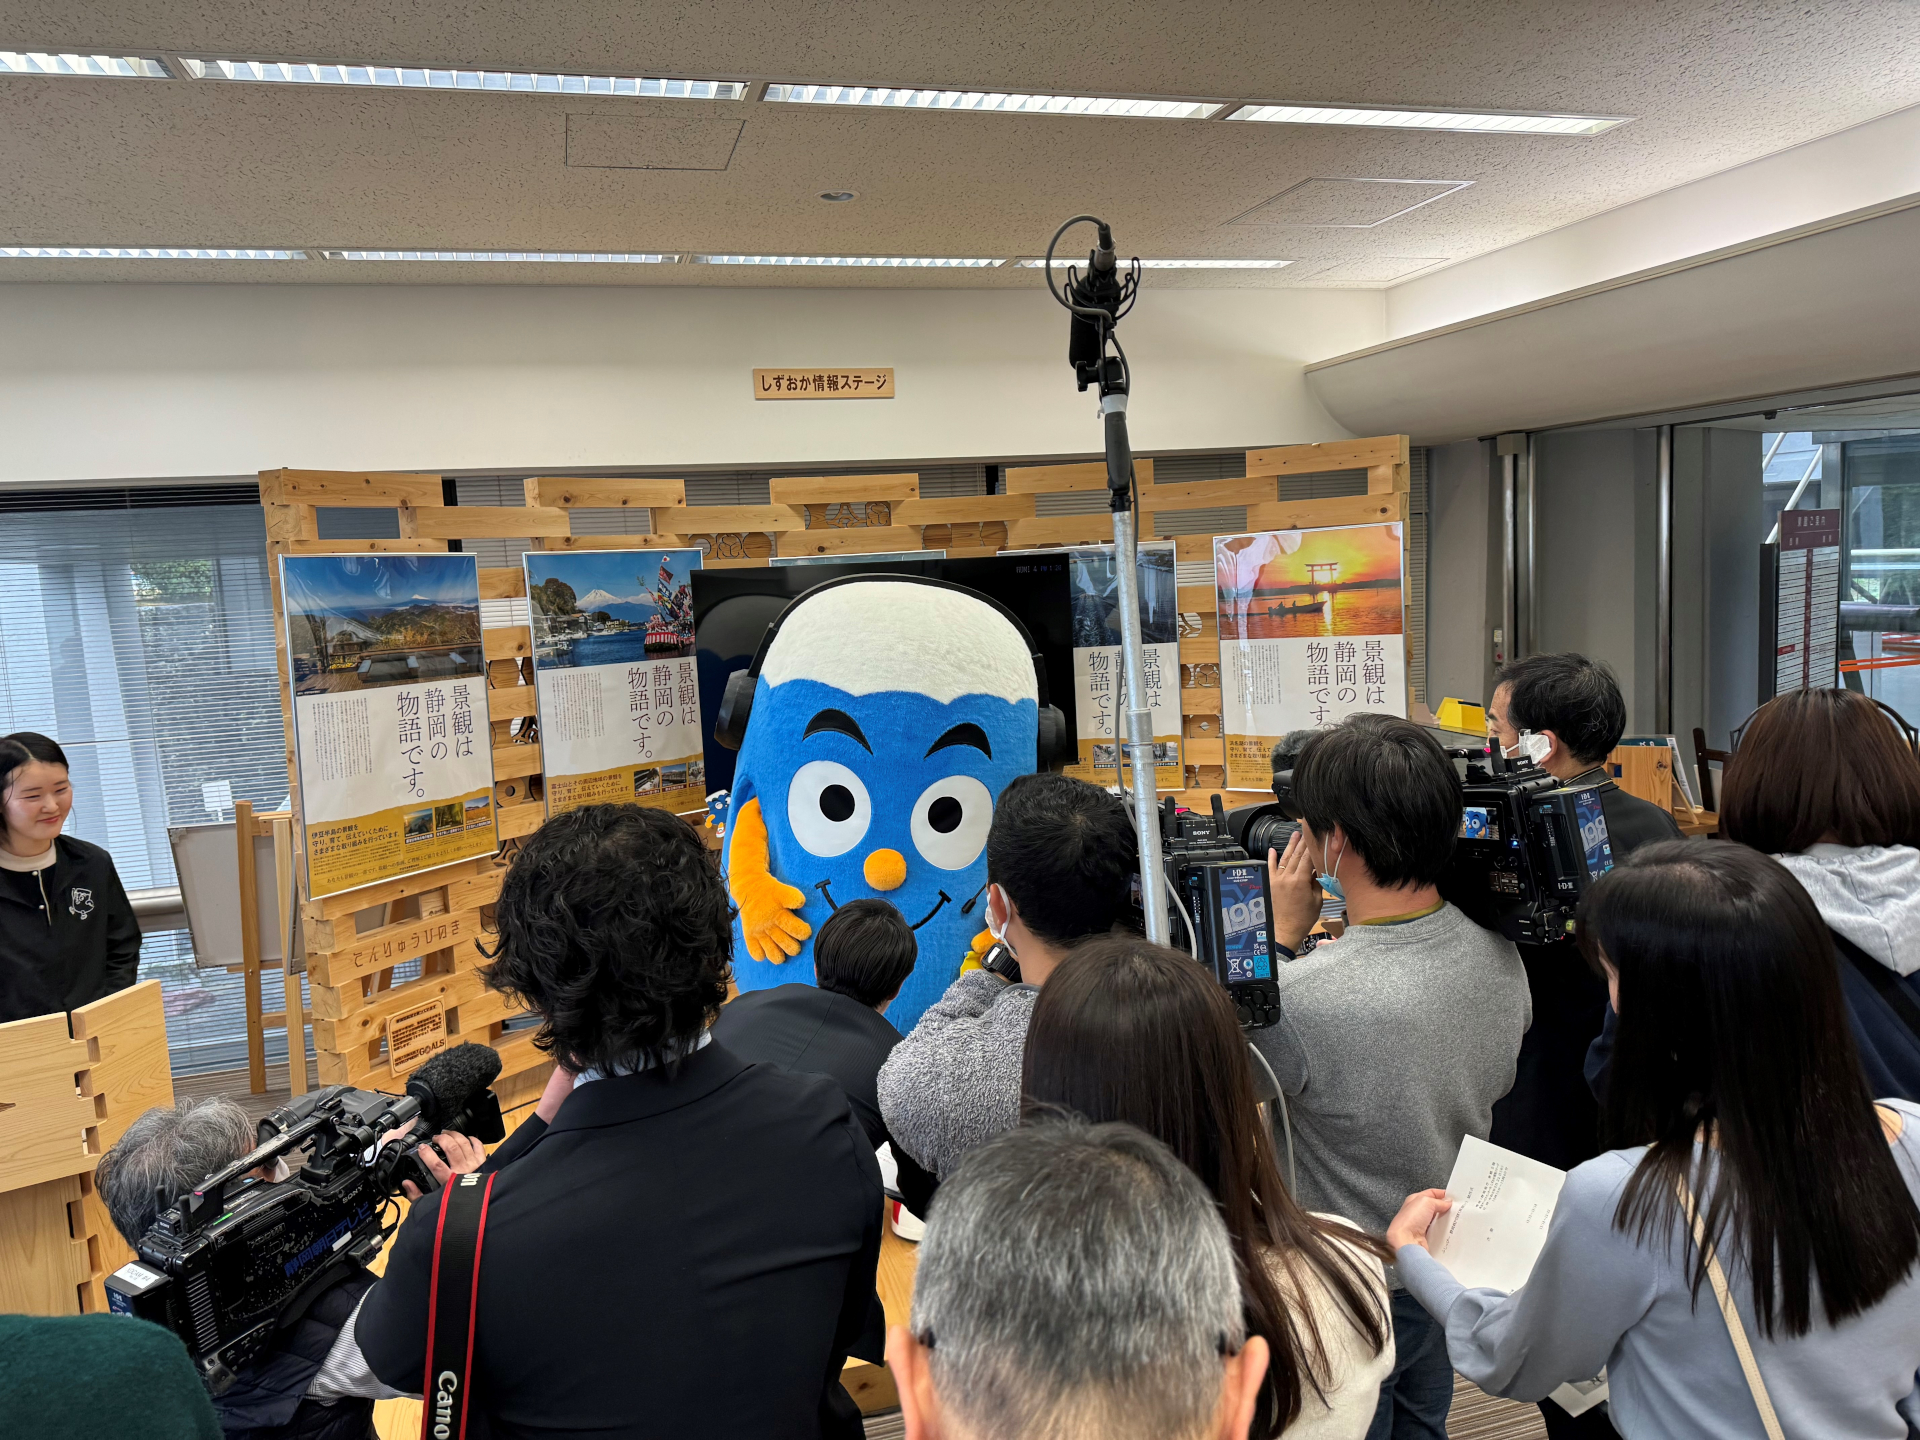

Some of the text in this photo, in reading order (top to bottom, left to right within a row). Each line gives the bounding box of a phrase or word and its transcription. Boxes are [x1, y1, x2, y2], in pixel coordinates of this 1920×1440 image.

[761, 374, 887, 392] しずおか情報ステージ
[652, 664, 674, 727] 静岡の
[676, 662, 696, 726] 景観は
[1088, 651, 1112, 735] 物語です。
[1142, 648, 1162, 709] 景観は
[1333, 641, 1357, 704] 静岡の
[1362, 640, 1386, 705] 景観は
[396, 691, 425, 798] 物語です。
[424, 687, 448, 761] 静岡の
[450, 684, 473, 759] 景観は
[627, 667, 653, 758] 物語です。
[1580, 815, 1608, 852] 198
[1221, 896, 1267, 936] 198
[283, 1201, 372, 1278] 静岡朝日テレビ
